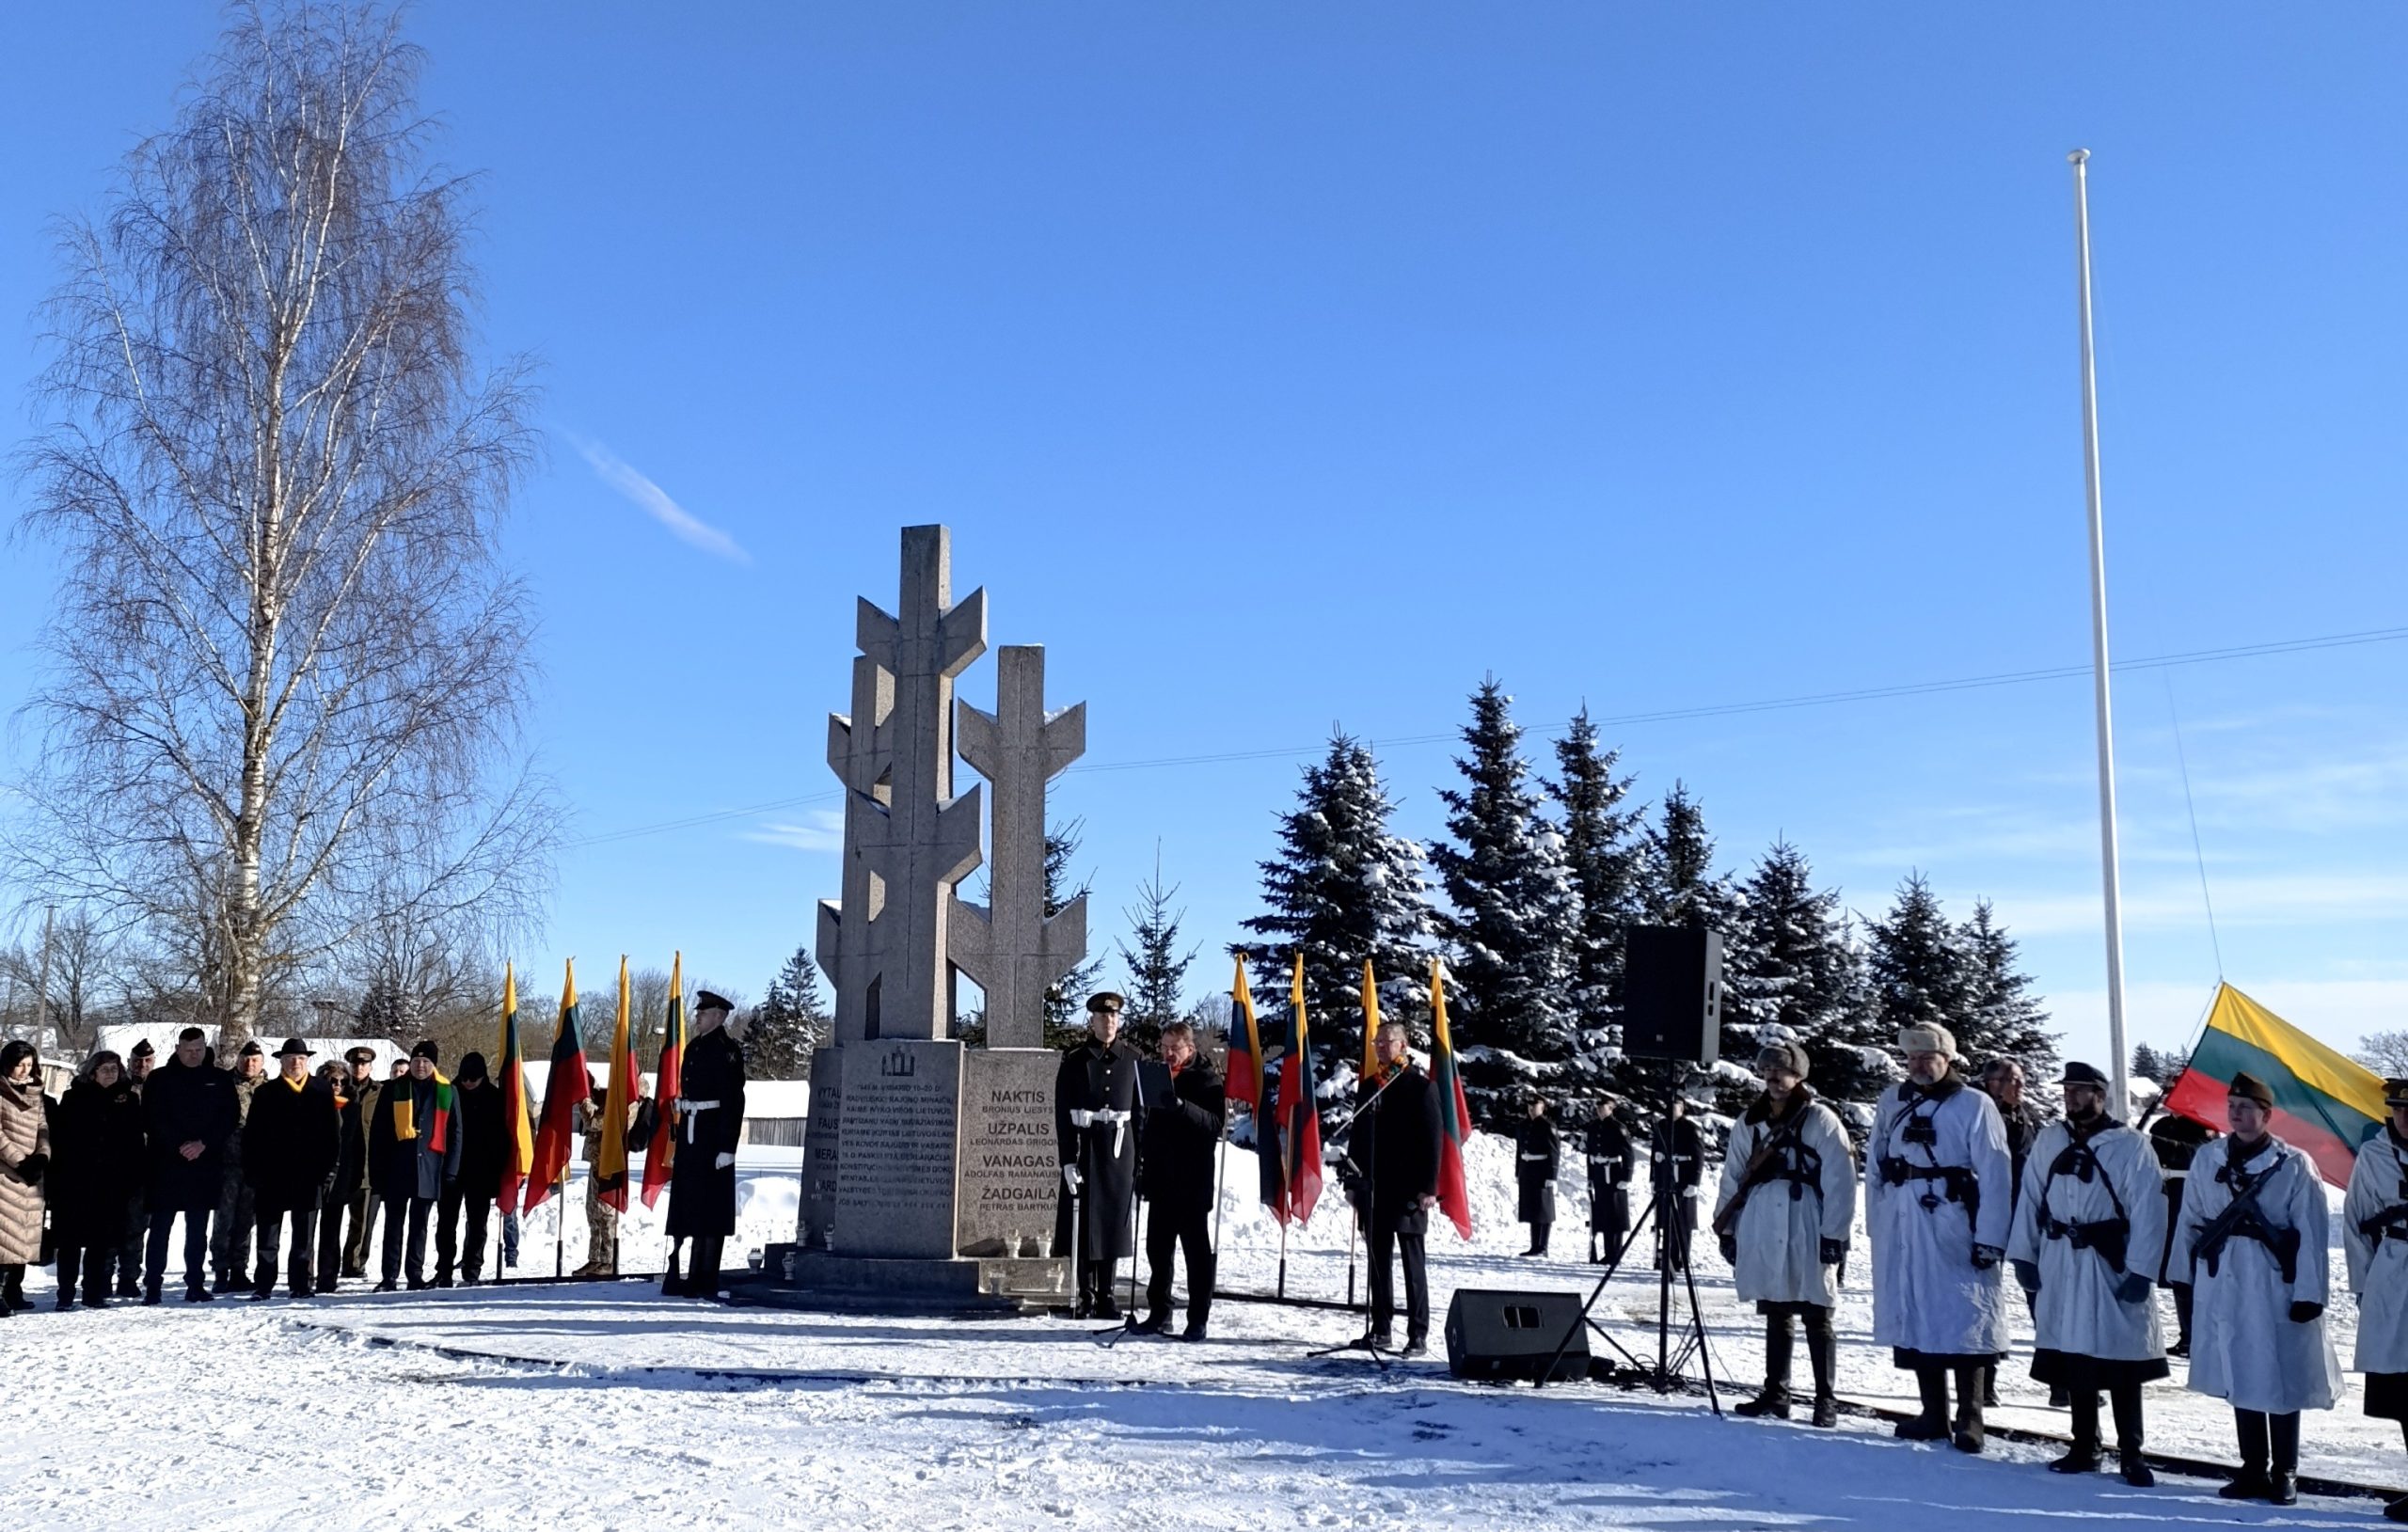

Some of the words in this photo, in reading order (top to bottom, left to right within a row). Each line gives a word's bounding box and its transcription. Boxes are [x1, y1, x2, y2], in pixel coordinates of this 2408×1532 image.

[991, 1091, 1045, 1103] NAKTIS
[982, 1105, 1021, 1113] BRONIUS
[1023, 1106, 1054, 1114] LIESYS
[818, 1117, 839, 1129] FAUS
[988, 1120, 1050, 1135] UŽPALIS
[970, 1138, 1023, 1146] LEONARDAS
[982, 1155, 1055, 1167] VANAGAS
[964, 1170, 1005, 1178] ADOLFAS
[981, 1185, 1057, 1200] ŽADGAILA
[979, 1203, 1014, 1211] PETRAS
